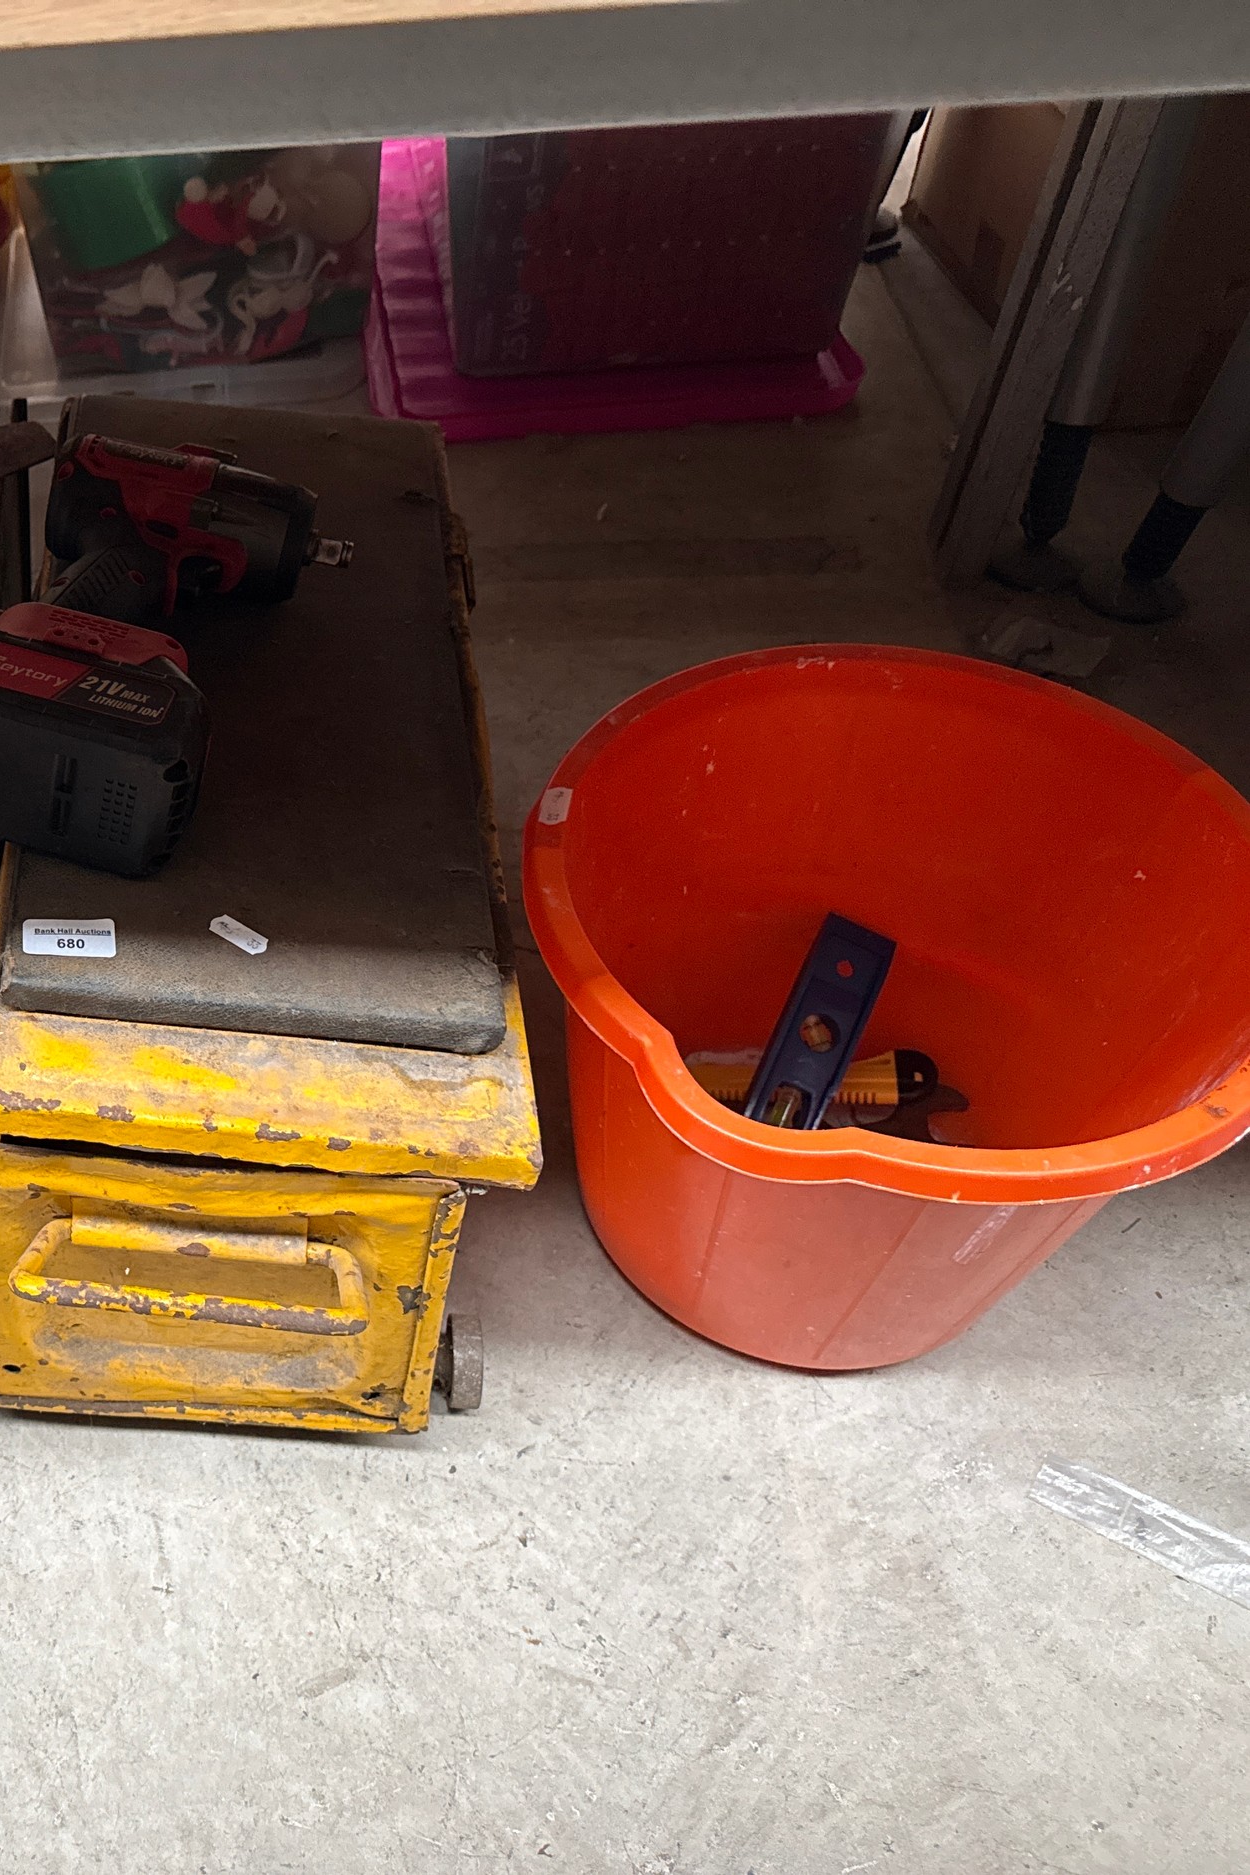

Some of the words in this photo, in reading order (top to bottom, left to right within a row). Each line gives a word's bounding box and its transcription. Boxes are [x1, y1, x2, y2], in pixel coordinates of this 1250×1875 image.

[79, 675, 126, 696] 21V
[119, 689, 151, 704] MAX
[88, 694, 138, 713] LITHIUM
[34, 928, 56, 936] Bank
[57, 928, 73, 936] Hall
[75, 928, 111, 937] Auctions
[56, 938, 85, 949] 680
